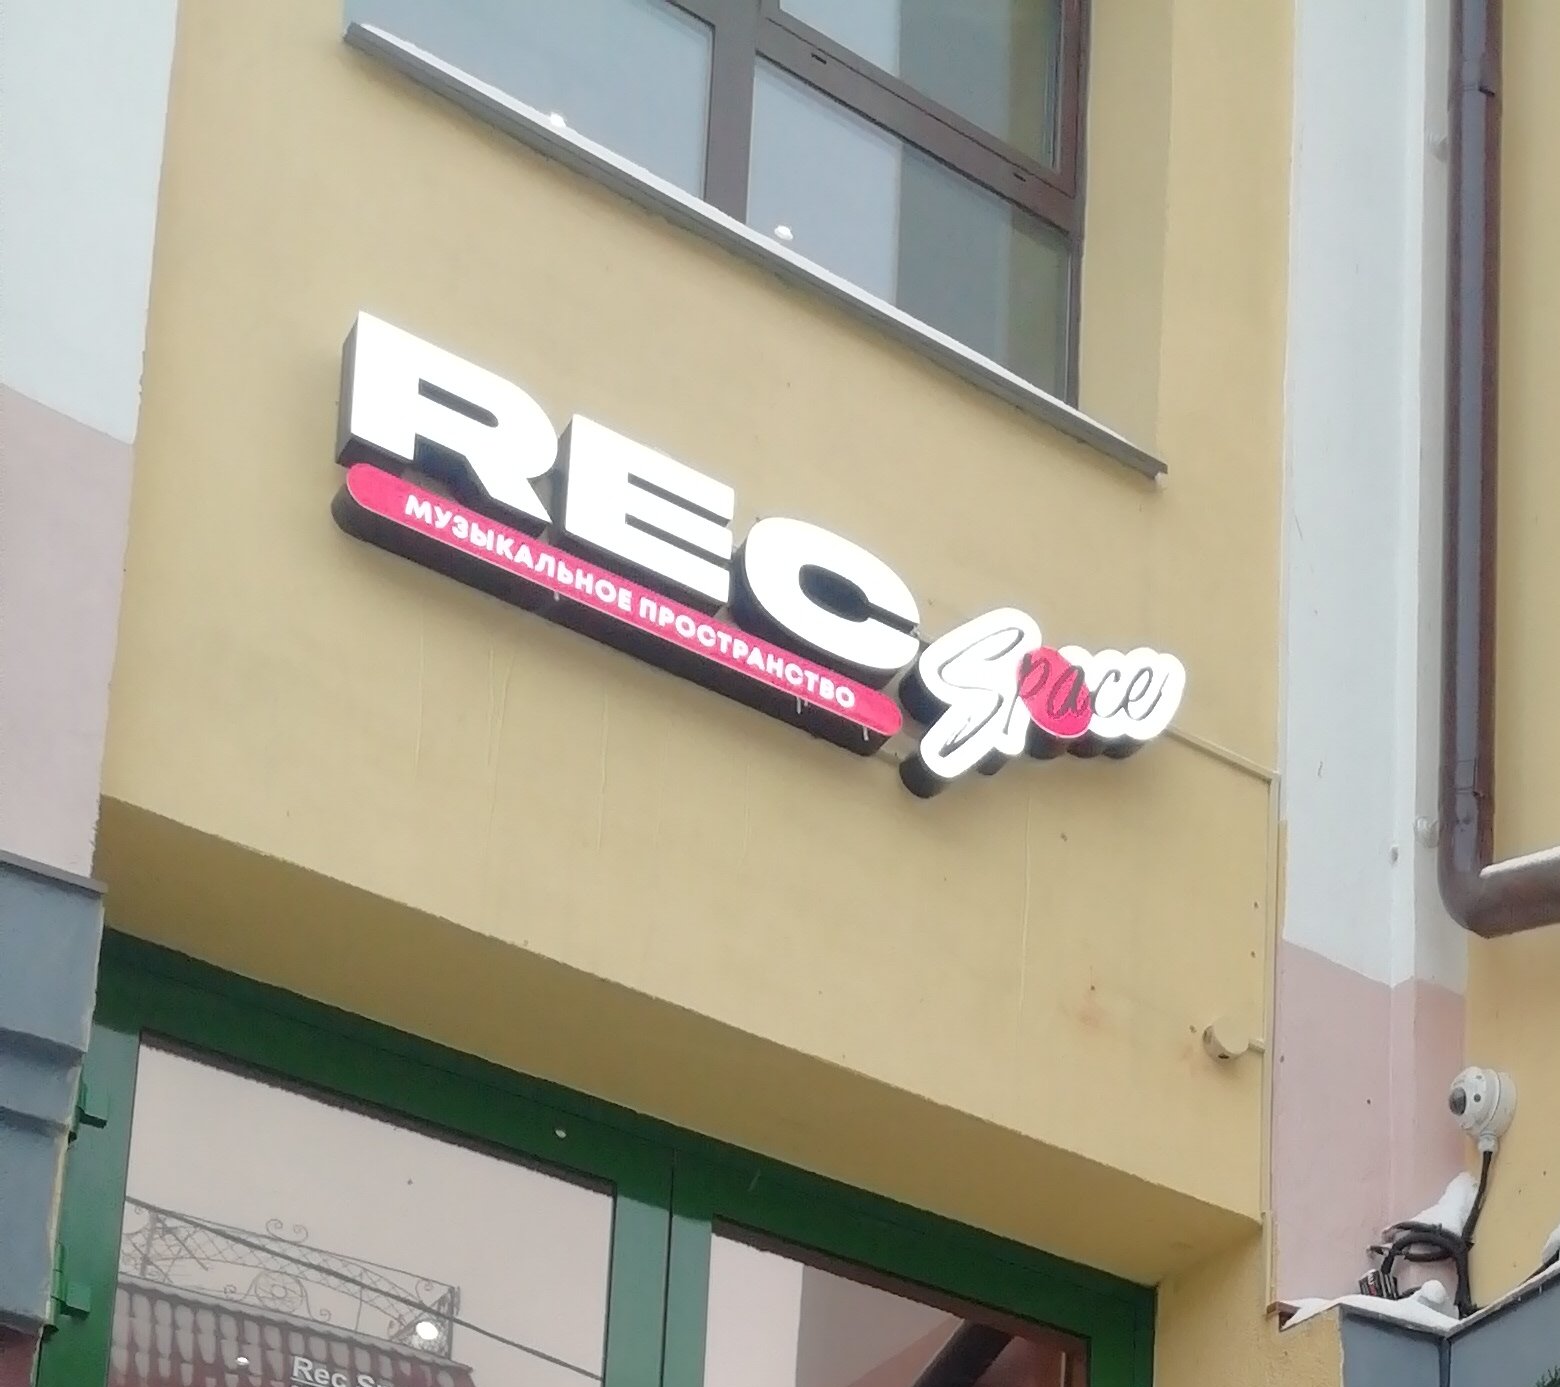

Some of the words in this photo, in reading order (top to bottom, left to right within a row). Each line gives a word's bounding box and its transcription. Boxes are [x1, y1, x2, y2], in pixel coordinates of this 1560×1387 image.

[346, 310, 920, 671] REC
[926, 615, 1180, 768] Space
[404, 494, 632, 613] МУЗЫКАЛЬНОЕ
[639, 596, 856, 710] ПРОСТРАНСТВО
